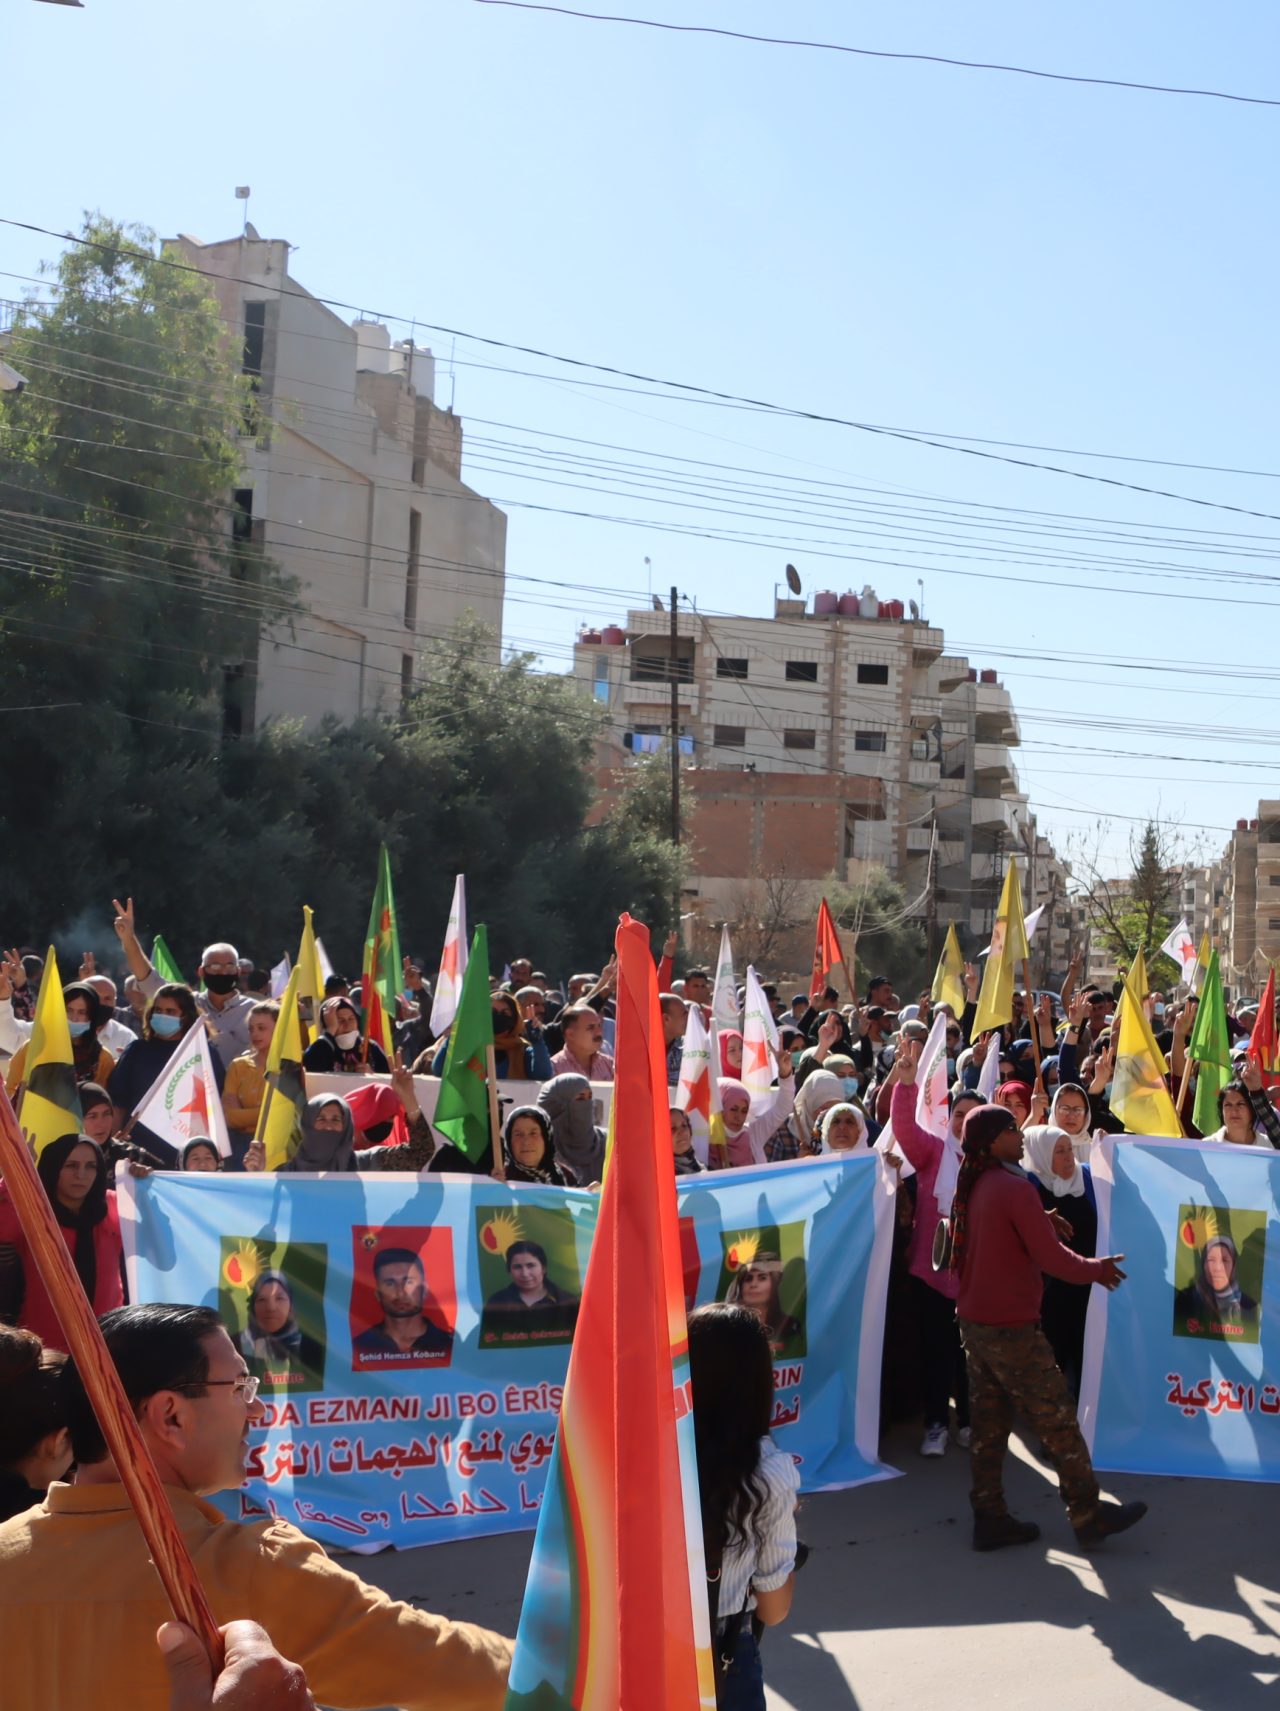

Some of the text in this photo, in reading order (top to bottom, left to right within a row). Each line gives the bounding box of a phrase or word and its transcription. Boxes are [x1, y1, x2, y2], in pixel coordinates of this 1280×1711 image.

[383, 1351, 411, 1360] Hemza
[309, 1398, 420, 1425] EZMANI
[427, 1396, 450, 1420] JI
[458, 1391, 497, 1417] BO
[1167, 1374, 1255, 1416] التركية
[329, 1433, 450, 1478] الهجمات
[456, 1430, 503, 1477] لمنع
